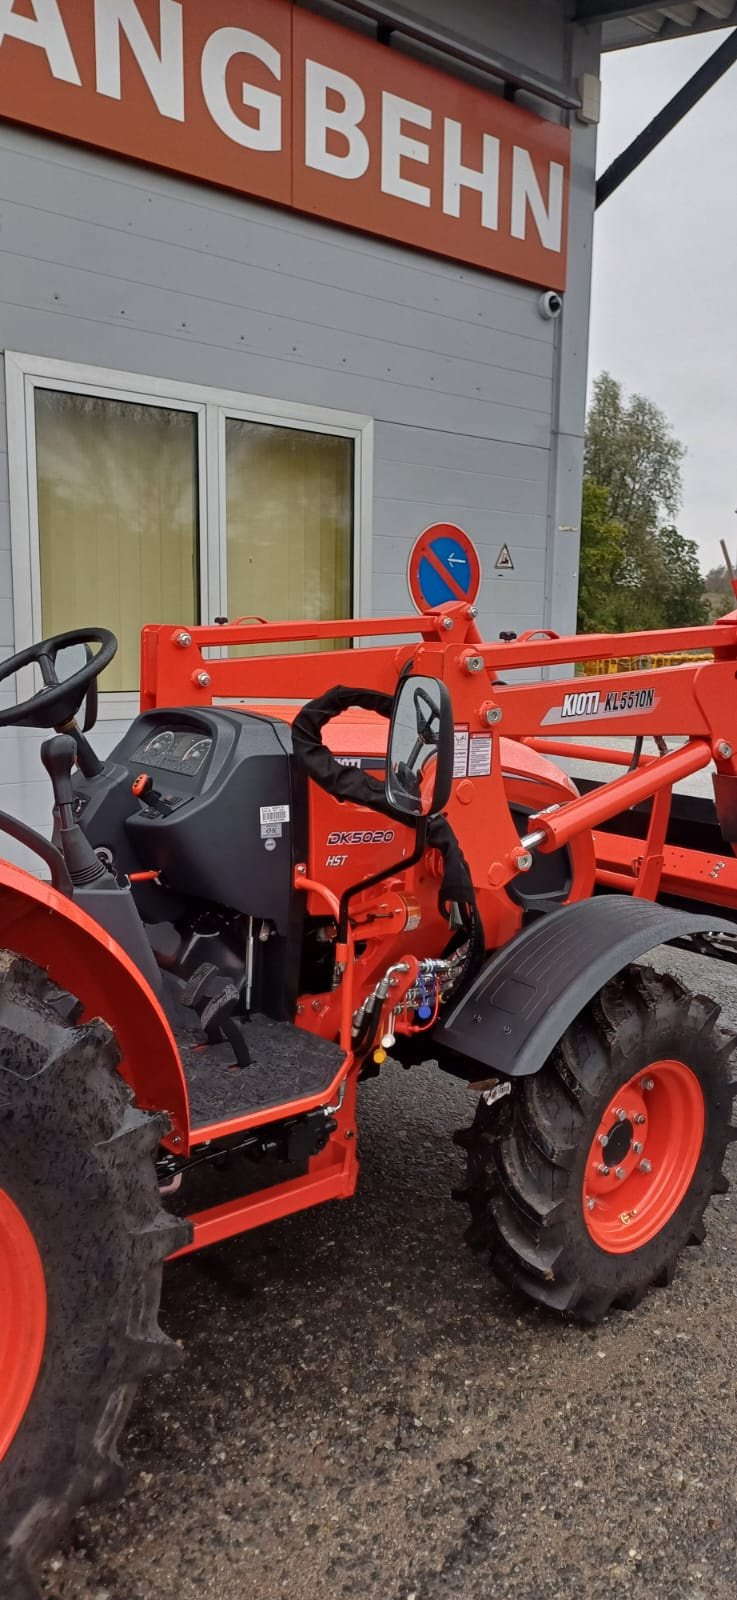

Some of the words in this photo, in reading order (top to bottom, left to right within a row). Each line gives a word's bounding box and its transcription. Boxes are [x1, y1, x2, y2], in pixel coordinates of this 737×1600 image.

[0, 0, 563, 253] ANGBEHN
[561, 691, 600, 717] KIOTI
[604, 689, 655, 711] KL5510N
[327, 831, 394, 846] DK5020
[325, 855, 348, 867] HST
